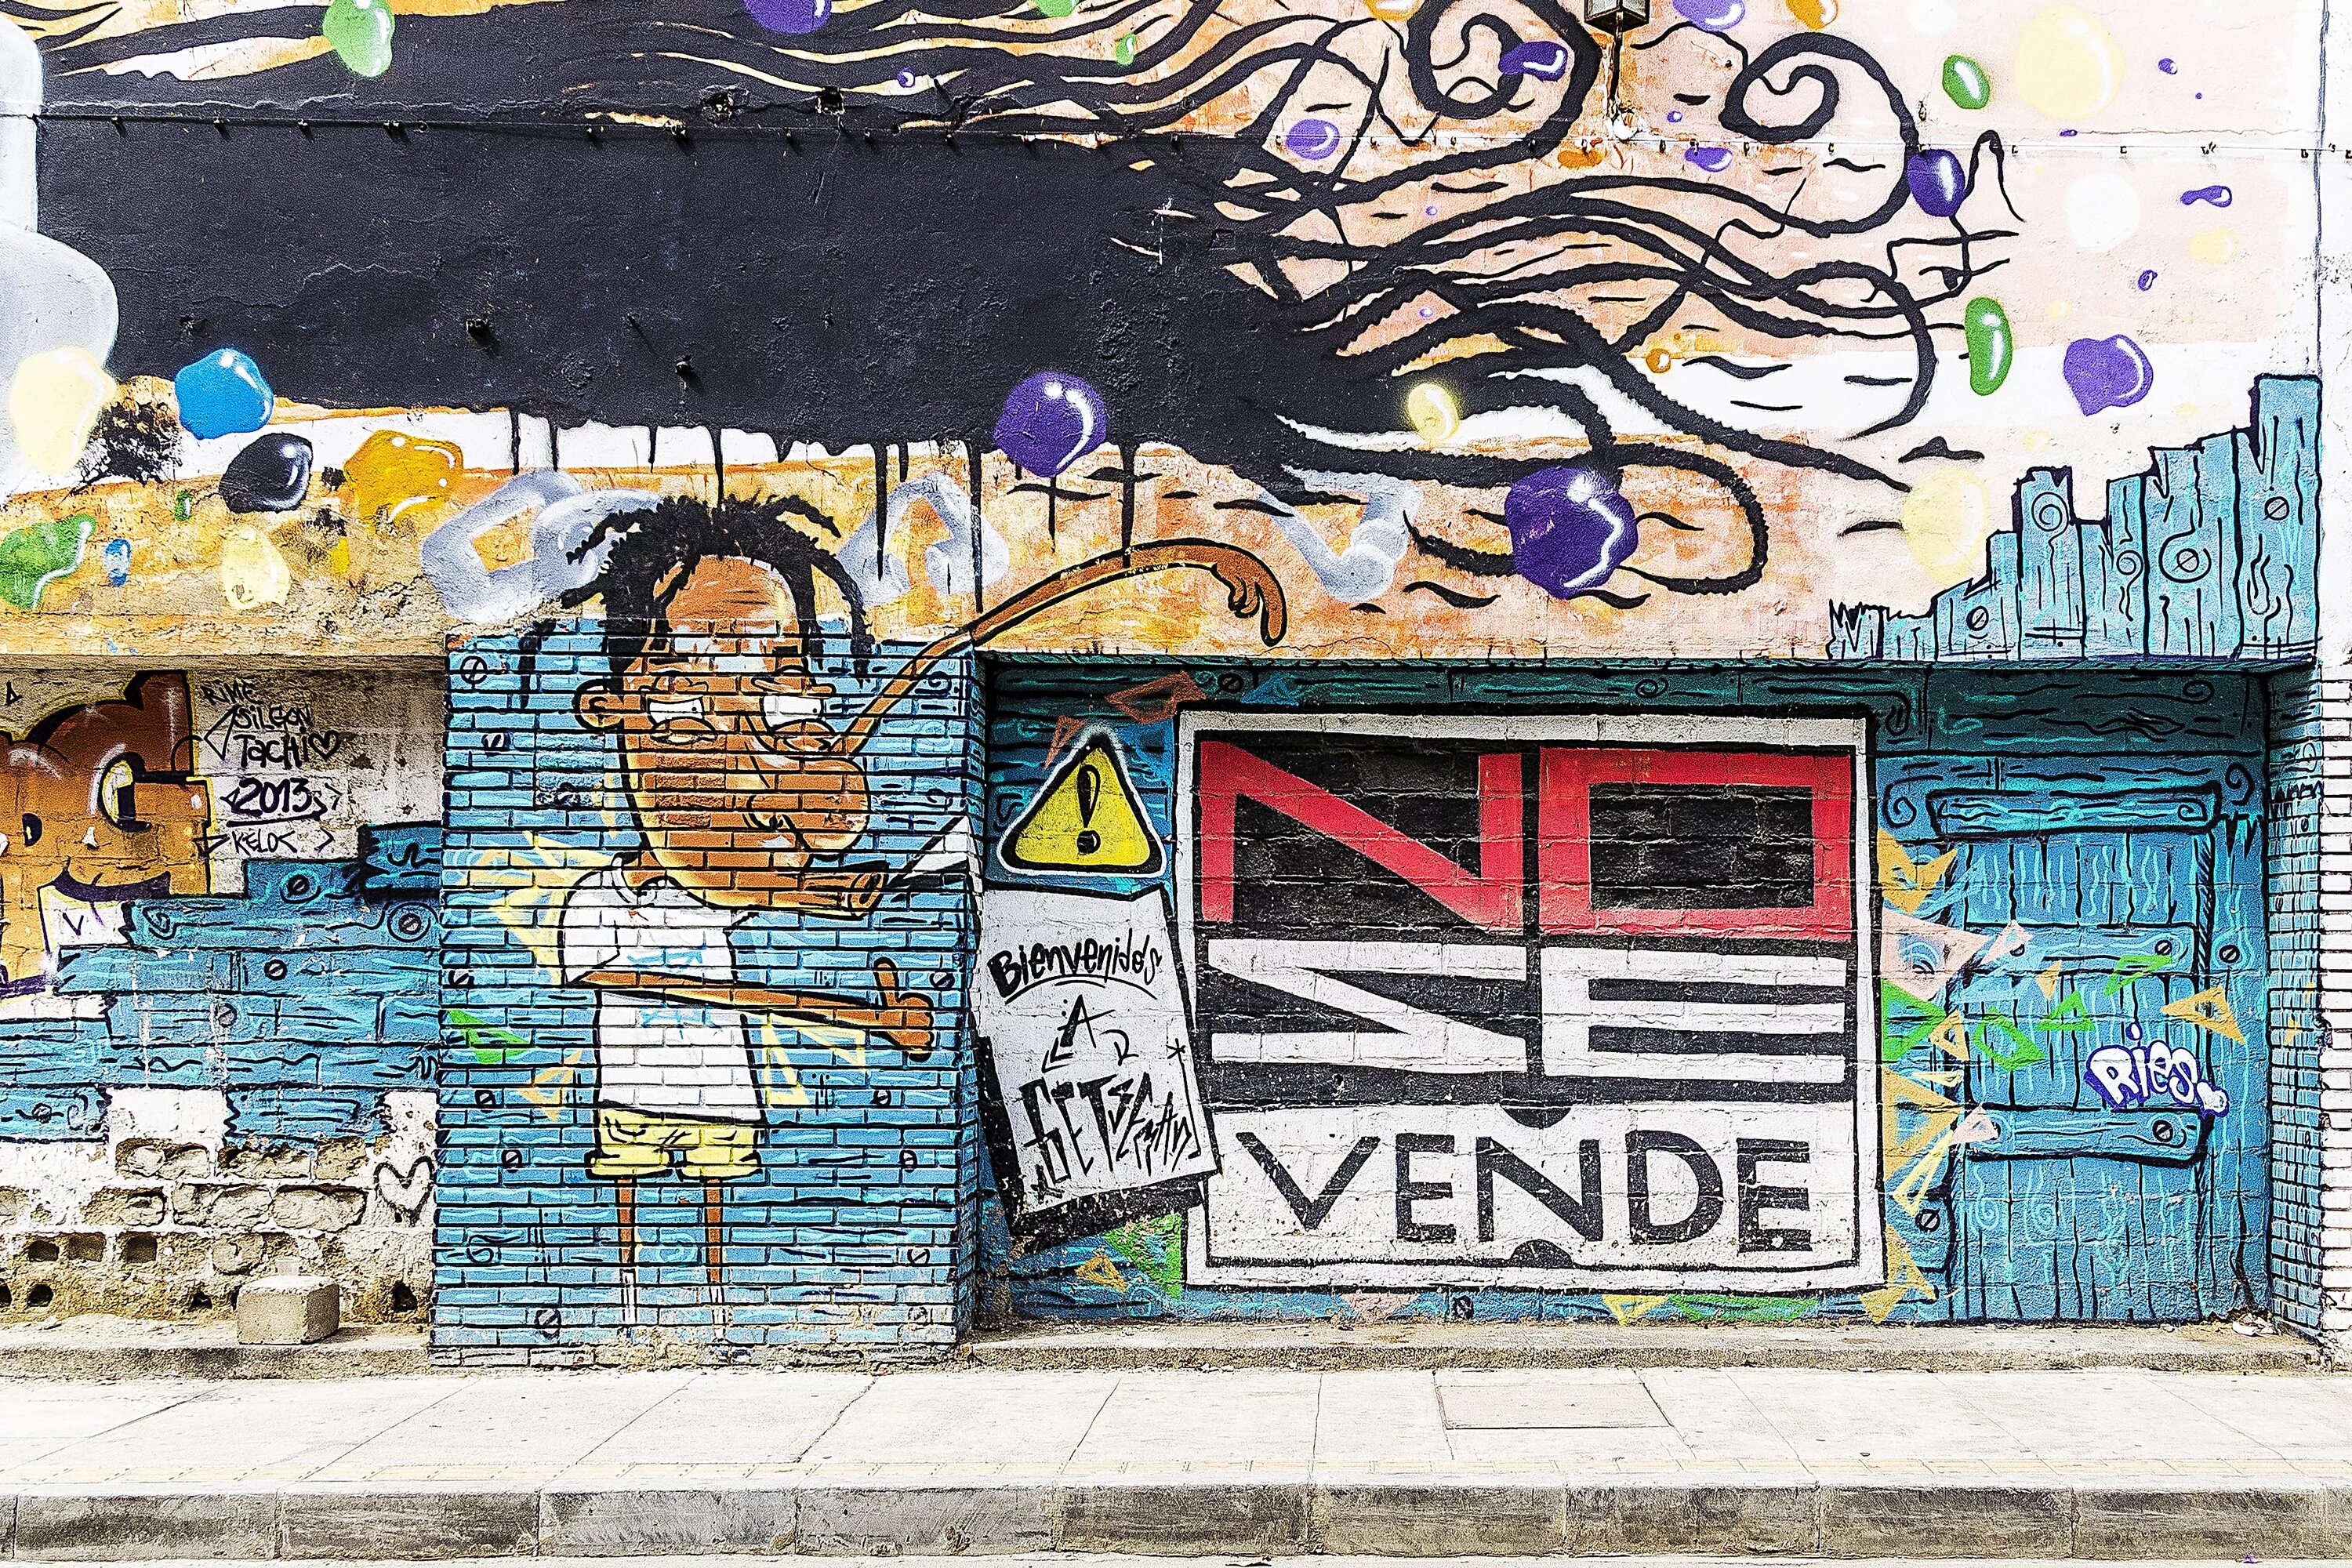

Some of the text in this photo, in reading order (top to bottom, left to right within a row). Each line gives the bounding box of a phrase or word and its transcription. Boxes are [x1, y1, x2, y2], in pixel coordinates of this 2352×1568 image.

[231, 777, 312, 817] 2013
[1200, 740, 1853, 943] NO
[986, 927, 1163, 998] Bienvenidos
[1207, 938, 1848, 1083] SE
[1236, 1131, 1813, 1254] VENDE
